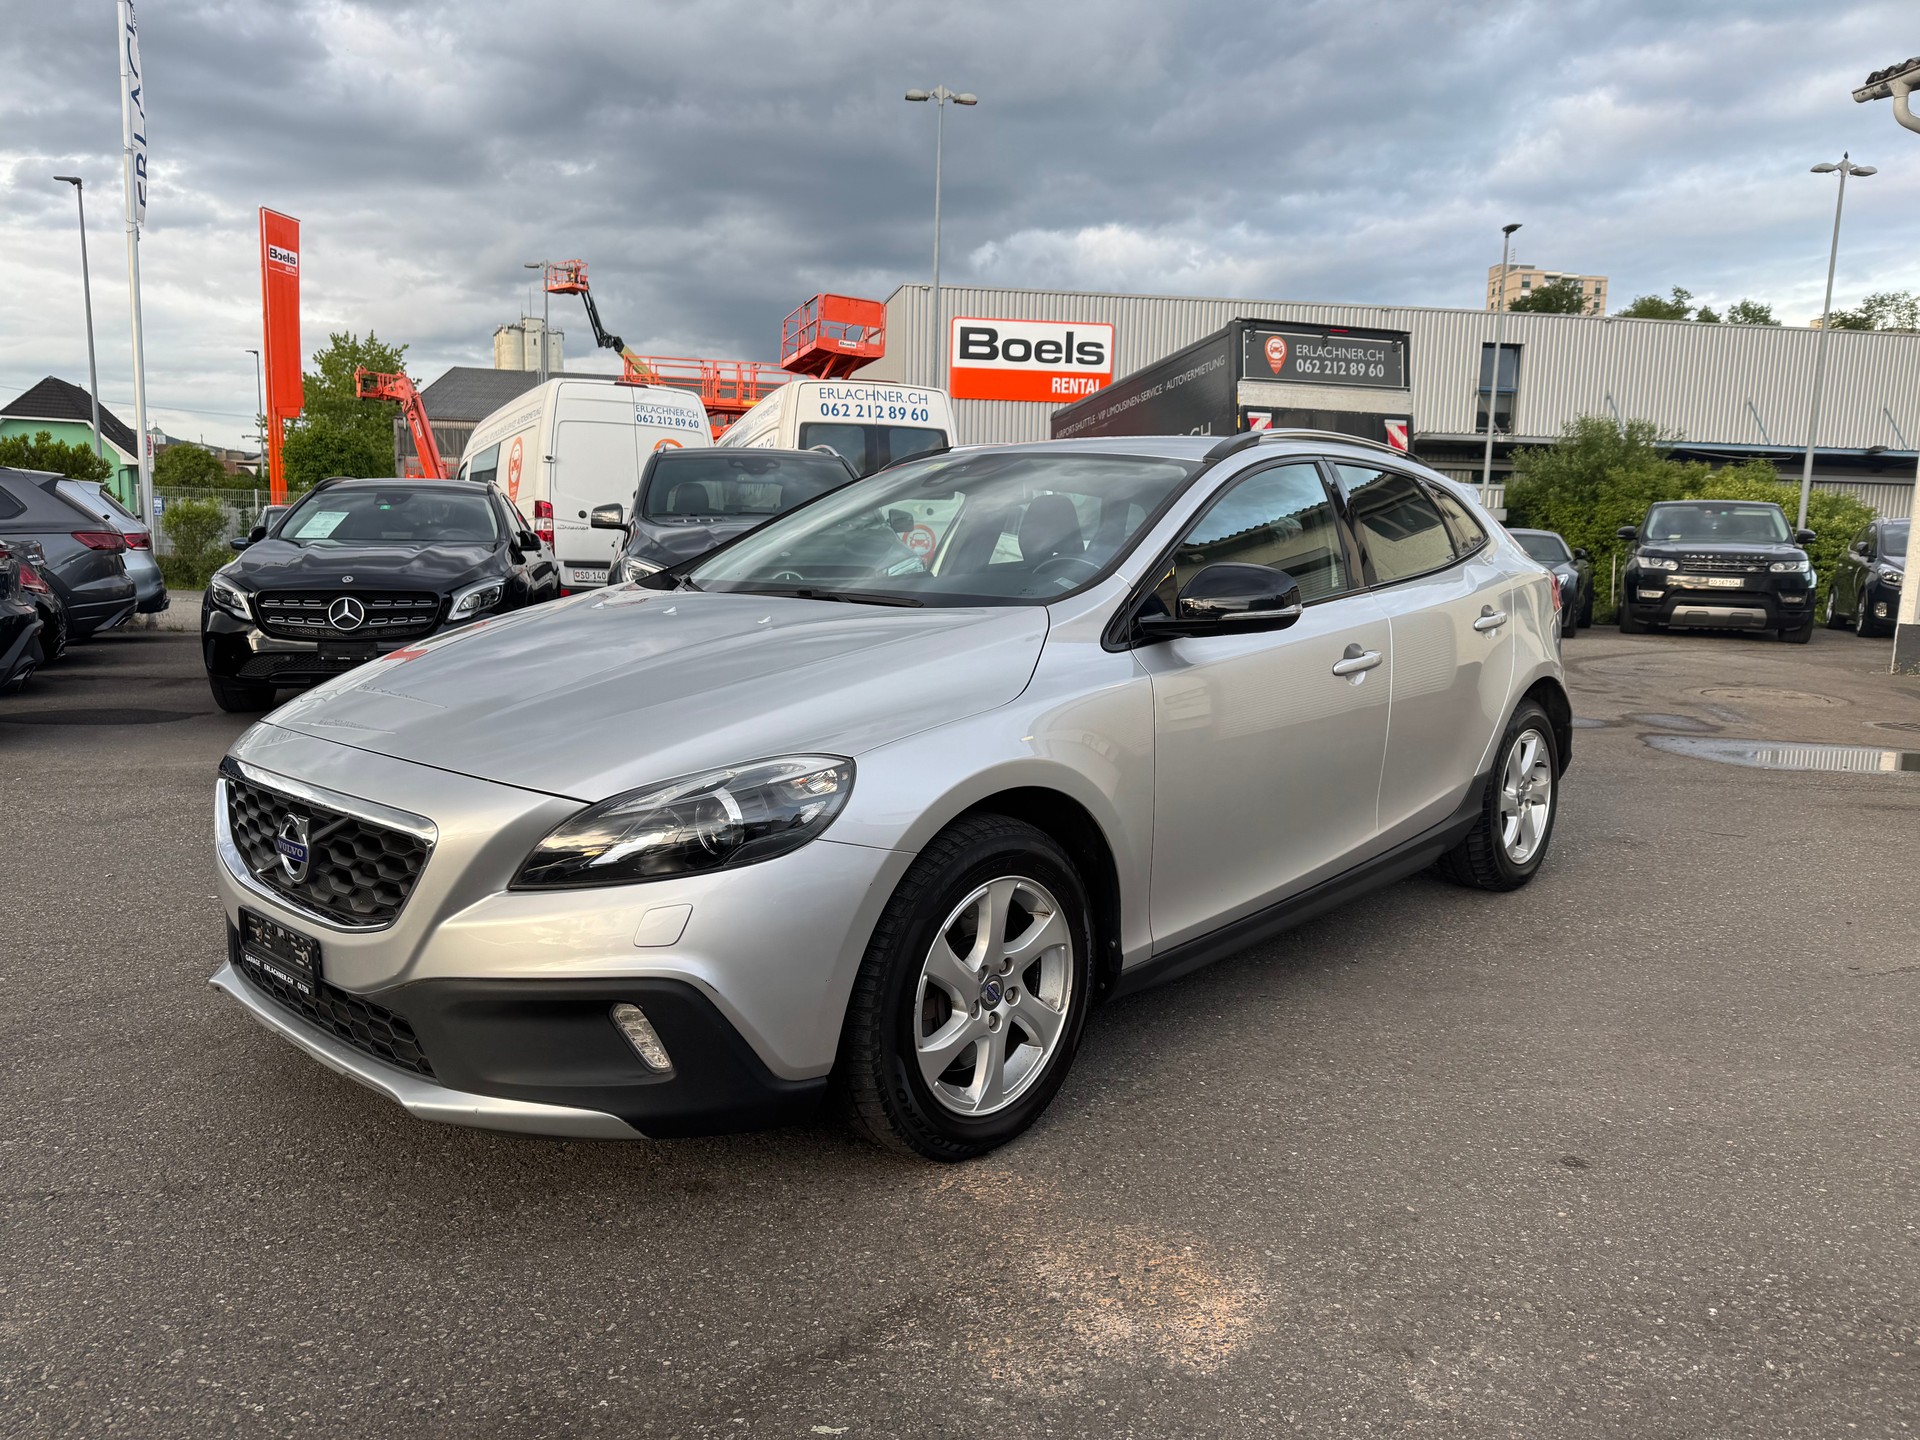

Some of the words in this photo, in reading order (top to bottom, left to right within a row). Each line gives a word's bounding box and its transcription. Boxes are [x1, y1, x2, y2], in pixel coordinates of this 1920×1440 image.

[269, 246, 297, 265] Boels
[959, 326, 1105, 366] Boels
[1296, 344, 1385, 362] ERLACHNER.CH
[1165, 354, 1226, 391] AUTOVERMIETUNG
[1296, 359, 1321, 374] 062
[1324, 360, 1347, 375] 212
[1349, 362, 1366, 377] 89
[1368, 364, 1385, 378] 60
[819, 387, 928, 405] ERLACHNER.CH
[635, 404, 699, 419] ERLACHNER.CH
[820, 402, 851, 417] 062
[856, 404, 885, 419] 212
[888, 406, 907, 420] 89
[911, 407, 929, 422] 60
[636, 414, 654, 424] 062
[657, 415, 673, 426] 212
[675, 417, 686, 428] 89
[688, 419, 699, 429] 60
[277, 840, 304, 858] VOLVO
[245, 954, 261, 967] GARAGE
[263, 963, 294, 985] ERLACHNER.CH
[297, 982, 310, 995] OLTEN
